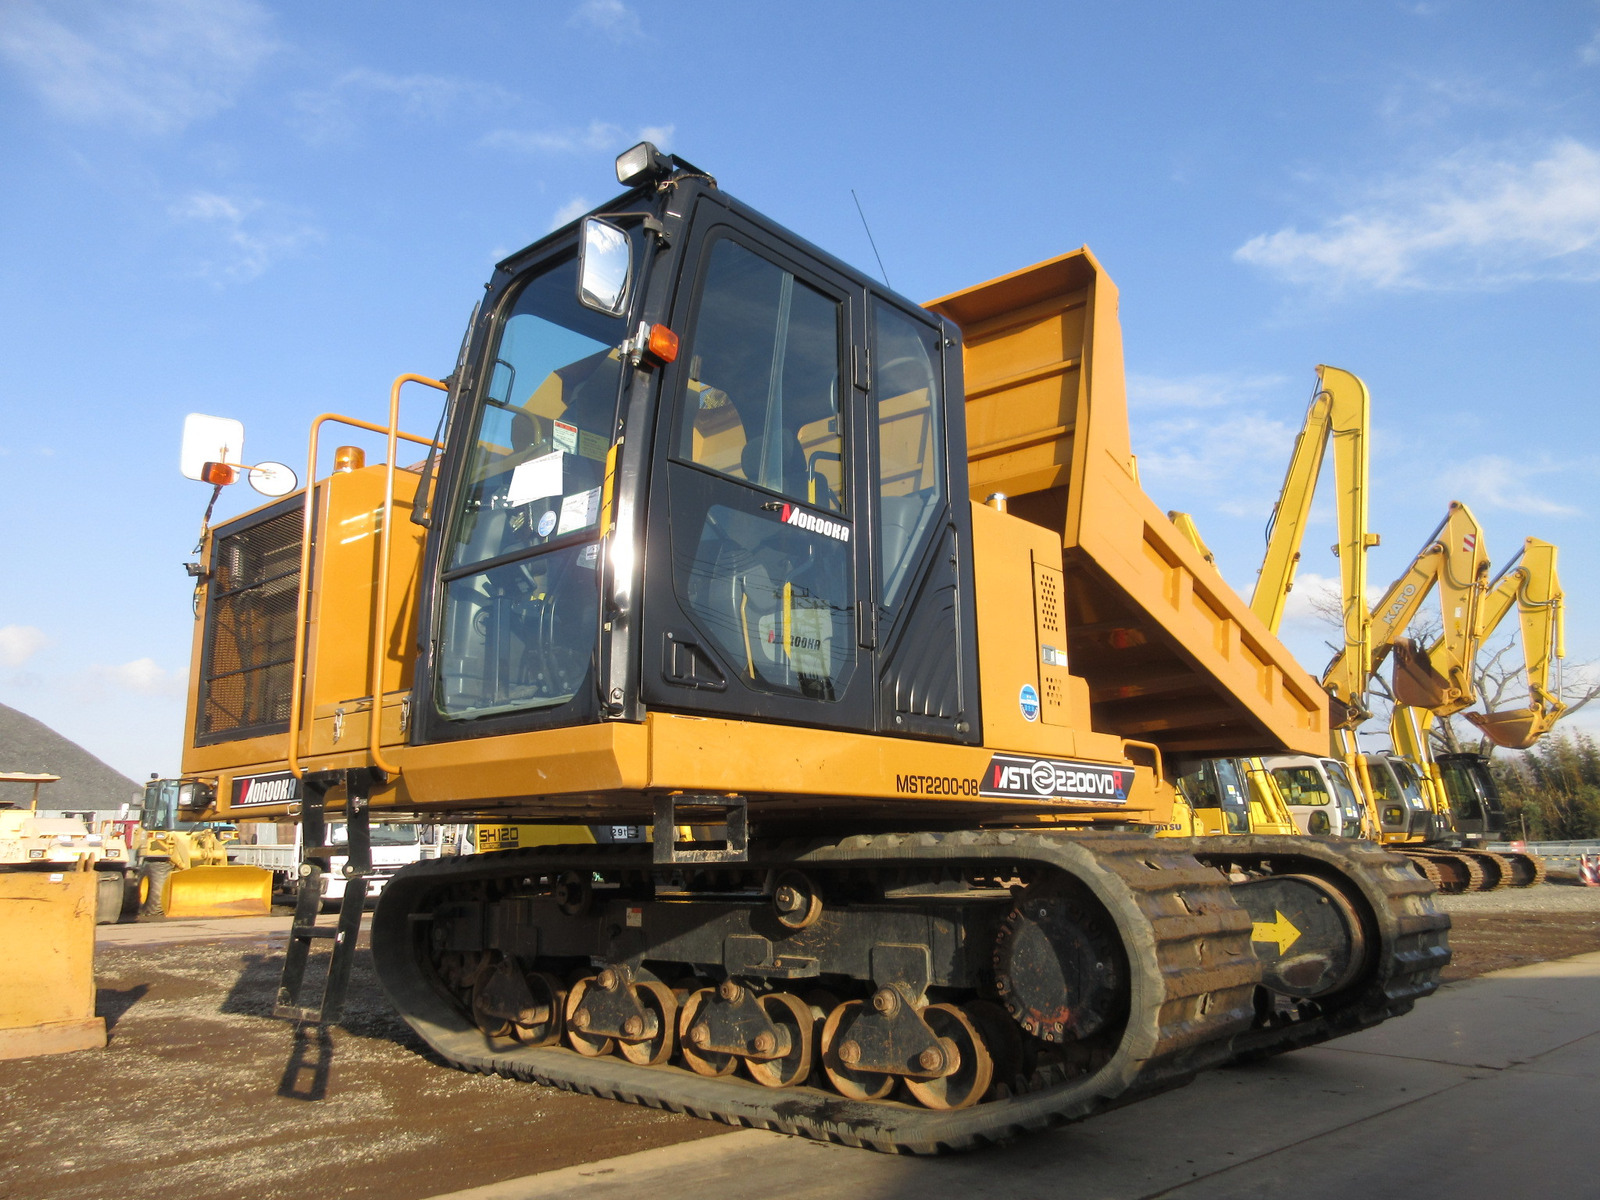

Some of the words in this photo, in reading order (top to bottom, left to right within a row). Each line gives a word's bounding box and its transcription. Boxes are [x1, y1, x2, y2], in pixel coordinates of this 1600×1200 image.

[781, 503, 849, 542] MOROOKA
[1382, 584, 1416, 625] KATO
[239, 778, 297, 804] MOROOKA
[896, 774, 979, 797] MST2200-08
